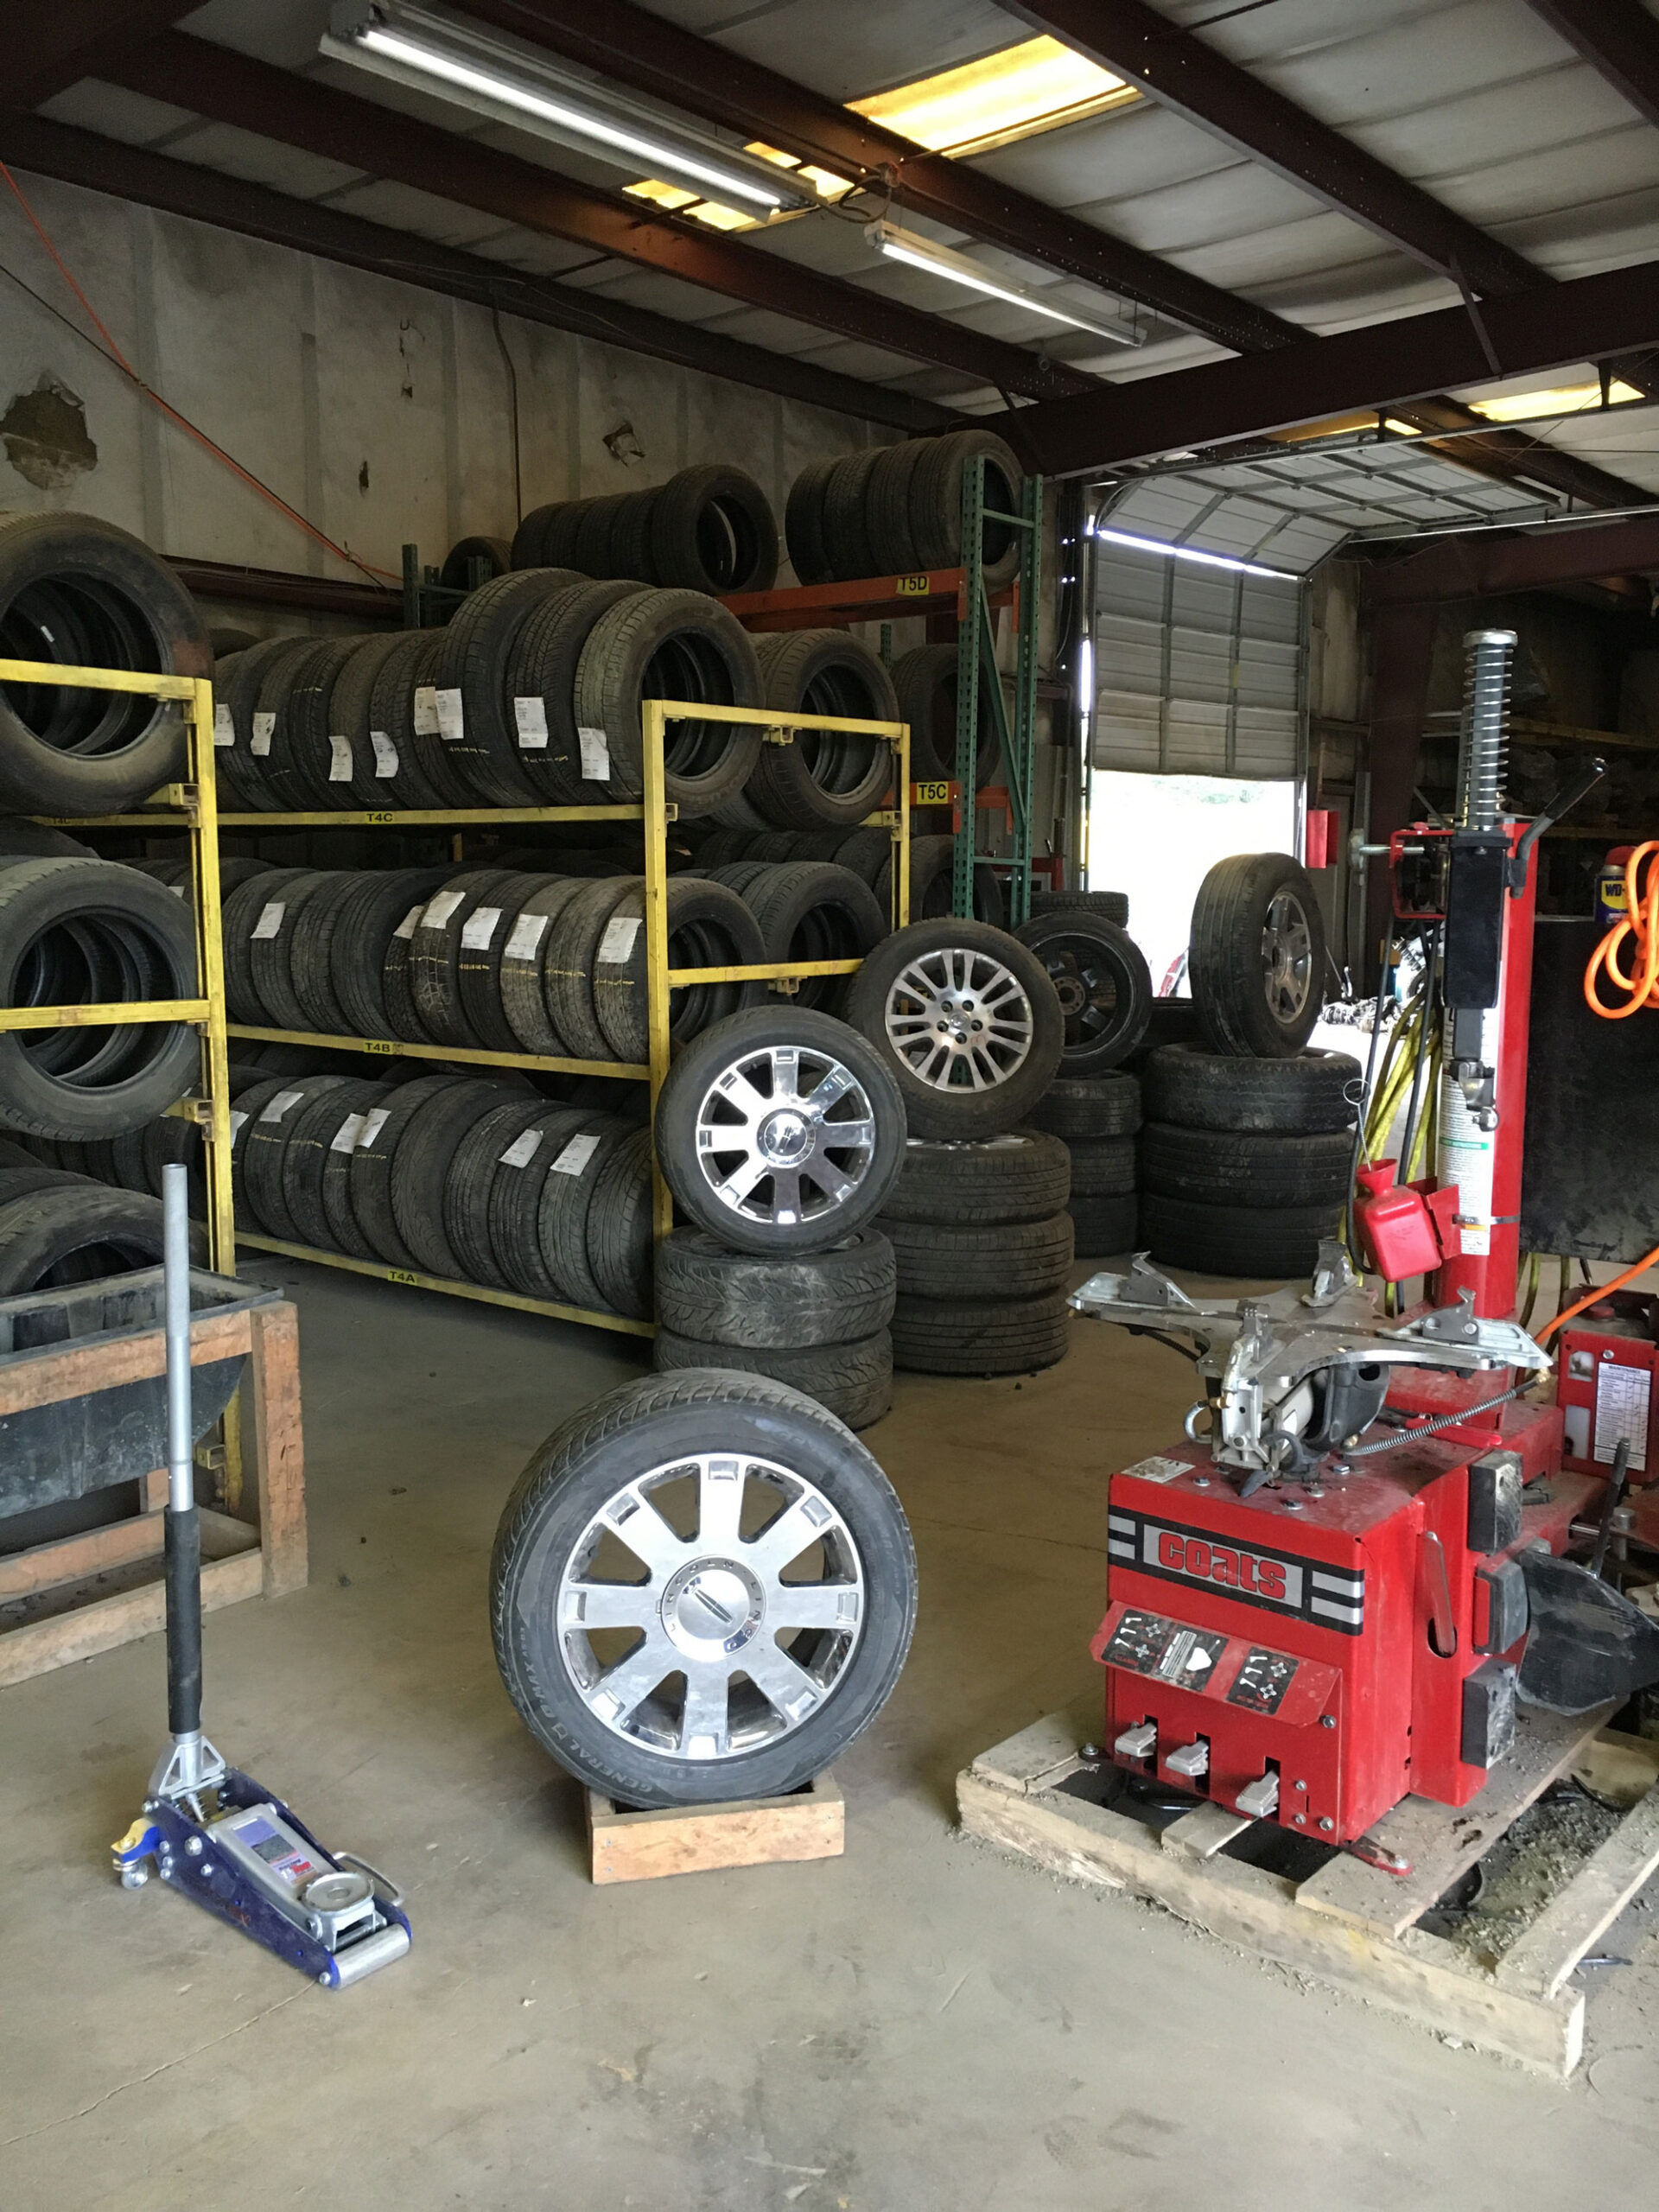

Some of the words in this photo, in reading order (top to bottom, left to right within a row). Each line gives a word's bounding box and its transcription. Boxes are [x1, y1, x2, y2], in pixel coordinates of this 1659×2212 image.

[899, 575, 928, 591] T5D
[918, 784, 946, 800] T5C
[366, 813, 393, 823] T4C
[1605, 884, 1625, 897] WD-
[365, 1042, 391, 1052] T4B
[390, 1271, 416, 1283] T4A
[569, 1738, 653, 1793] GENERAL
